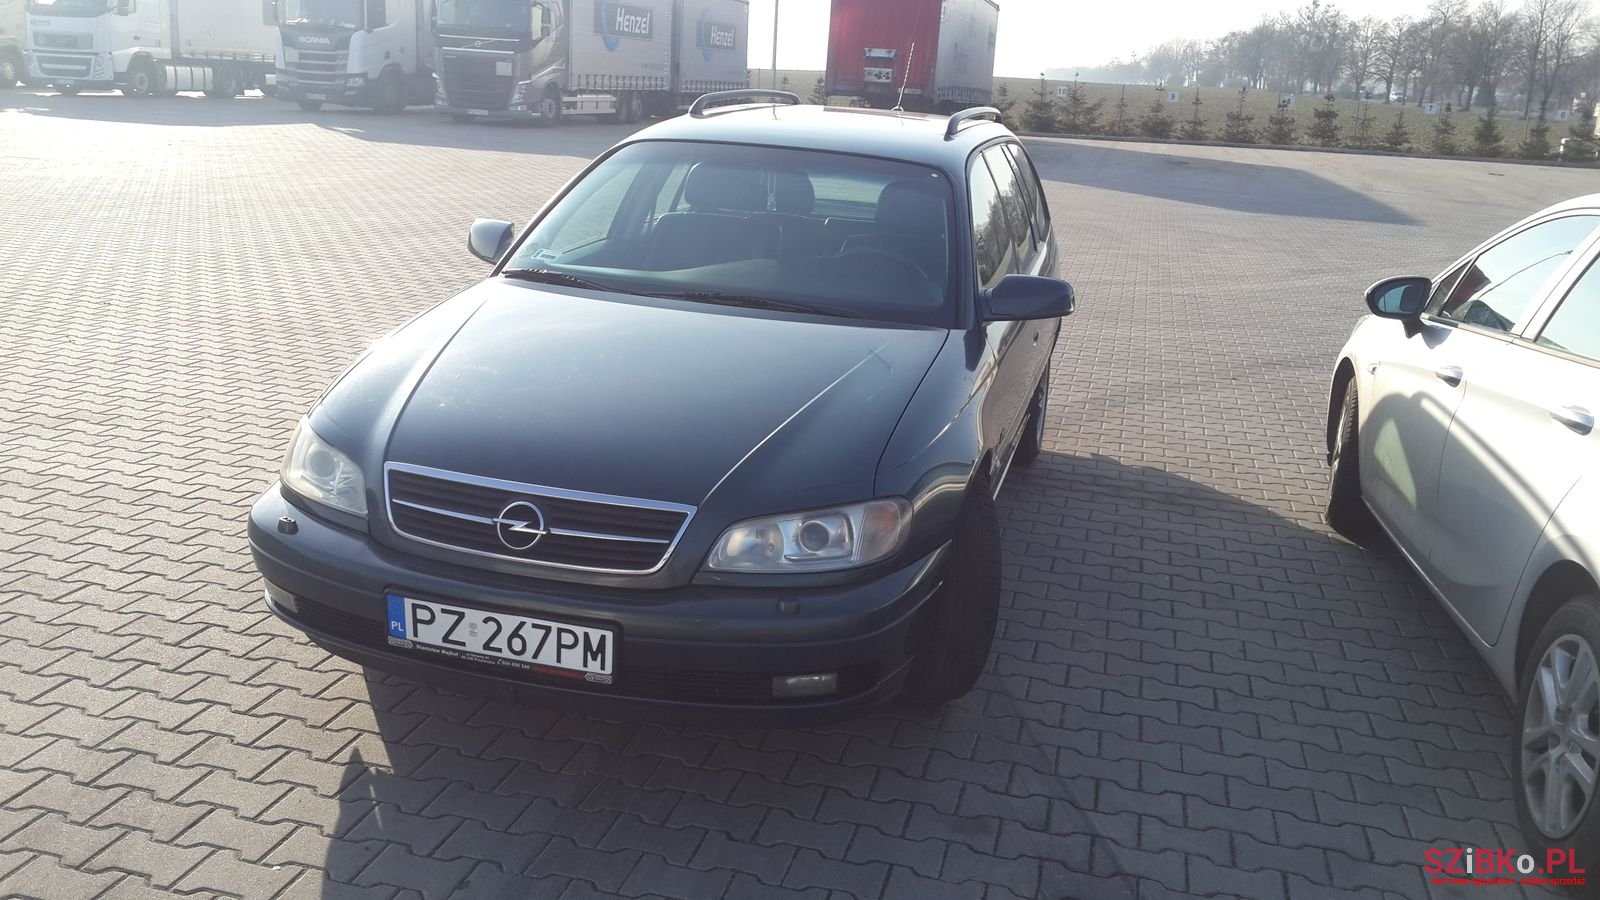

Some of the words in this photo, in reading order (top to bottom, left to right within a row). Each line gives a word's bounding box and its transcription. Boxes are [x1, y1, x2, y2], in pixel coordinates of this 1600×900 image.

[615, 8, 650, 34] Henzel
[299, 36, 330, 44] SCANIA
[710, 25, 735, 46] Henzel
[391, 620, 404, 632] PL
[411, 603, 466, 647] PZ
[482, 616, 606, 671] 267PM
